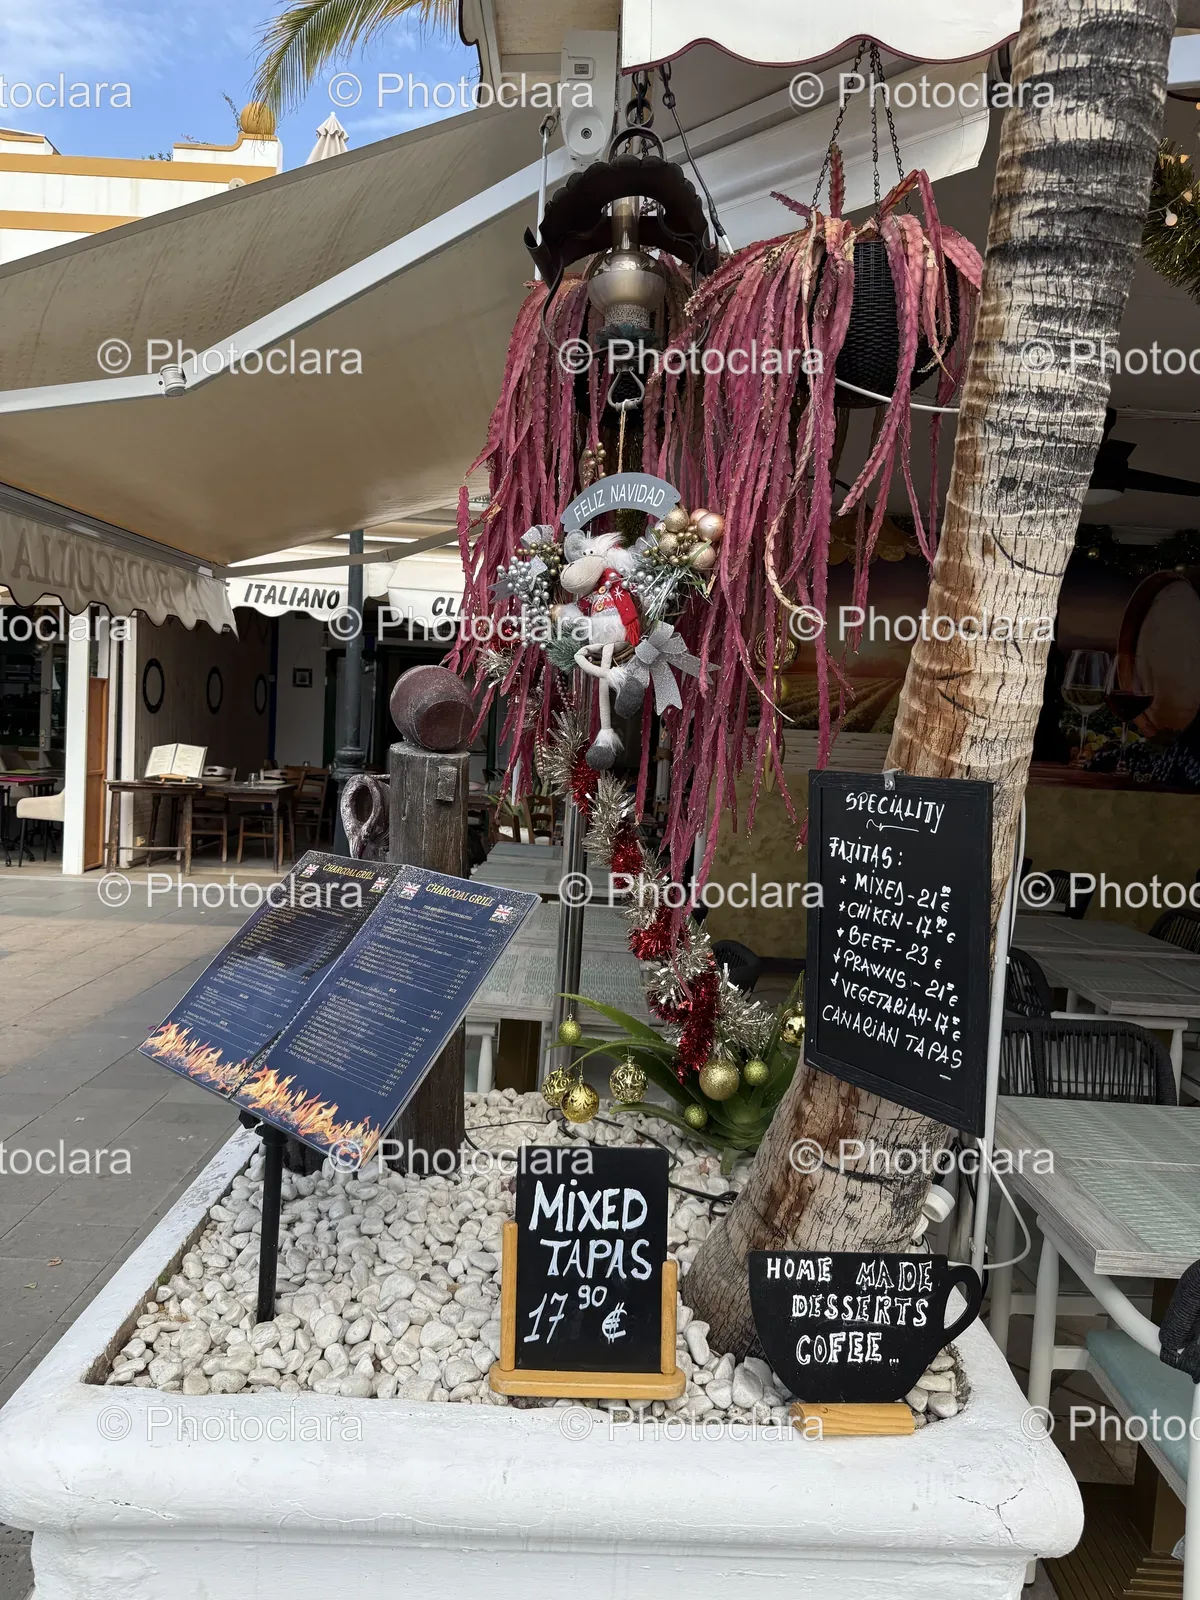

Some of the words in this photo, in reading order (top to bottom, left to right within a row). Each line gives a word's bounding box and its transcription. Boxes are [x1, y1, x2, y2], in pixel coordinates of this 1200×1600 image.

[573, 489, 606, 522] FELIZ
[610, 483, 665, 507] NAVIDAD
[244, 583, 340, 610] ITALIANO
[323, 863, 358, 878] CHARCOAL
[355, 869, 376, 880] GRILL
[425, 883, 468, 903] CHARCOAL
[468, 893, 495, 907] GRILL
[843, 949, 906, 989] PRAWNS
[905, 943, 929, 966] 23
[822, 1004, 900, 1047] CANARIAN
[905, 1034, 962, 1069] TAPAS
[540, 1238, 652, 1280] TAPAS
[767, 1256, 833, 1282] HOME
[856, 1260, 934, 1293] MADE
[791, 1293, 929, 1327] DESSERTS
